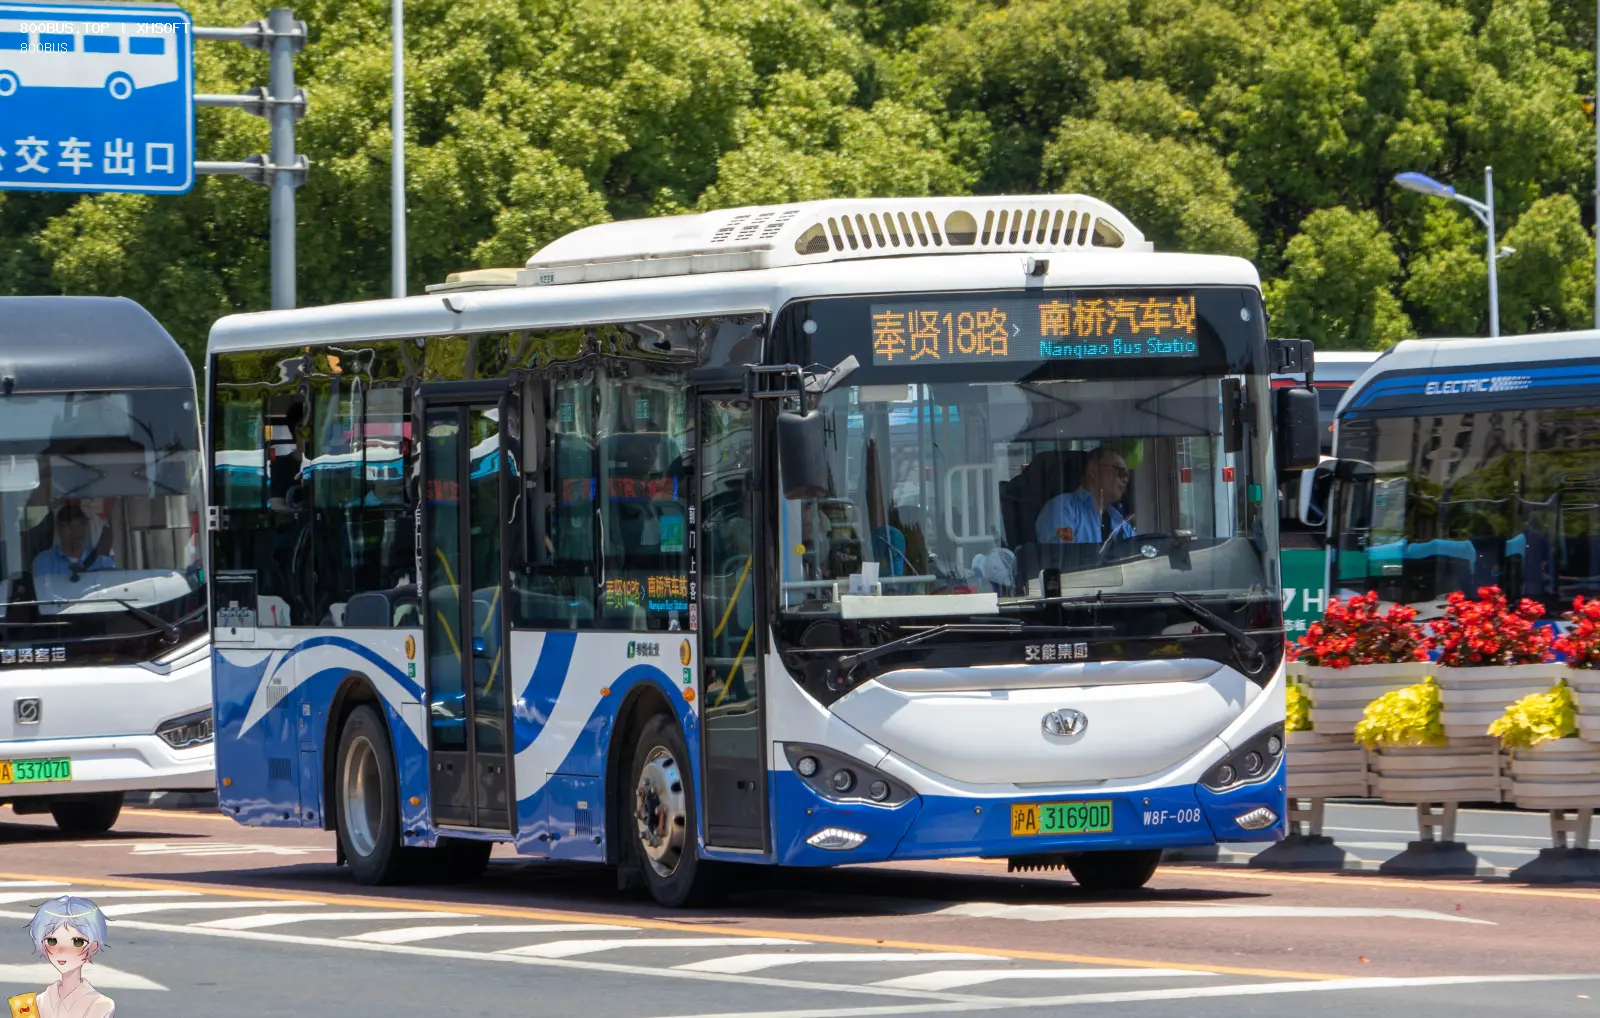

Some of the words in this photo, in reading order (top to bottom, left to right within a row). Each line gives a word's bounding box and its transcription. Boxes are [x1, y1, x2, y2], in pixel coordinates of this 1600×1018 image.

[0, 136, 175, 176] 交车出口
[872, 307, 1009, 361] 奉贤18路
[1038, 296, 1197, 337] 南桥汽车站
[1038, 339, 1108, 359] Nanqiao
[1112, 337, 1142, 355] Bus
[1146, 335, 1197, 354] Statio
[1424, 378, 1490, 395] ELECTRIC
[1143, 808, 1201, 826] W8F-008
